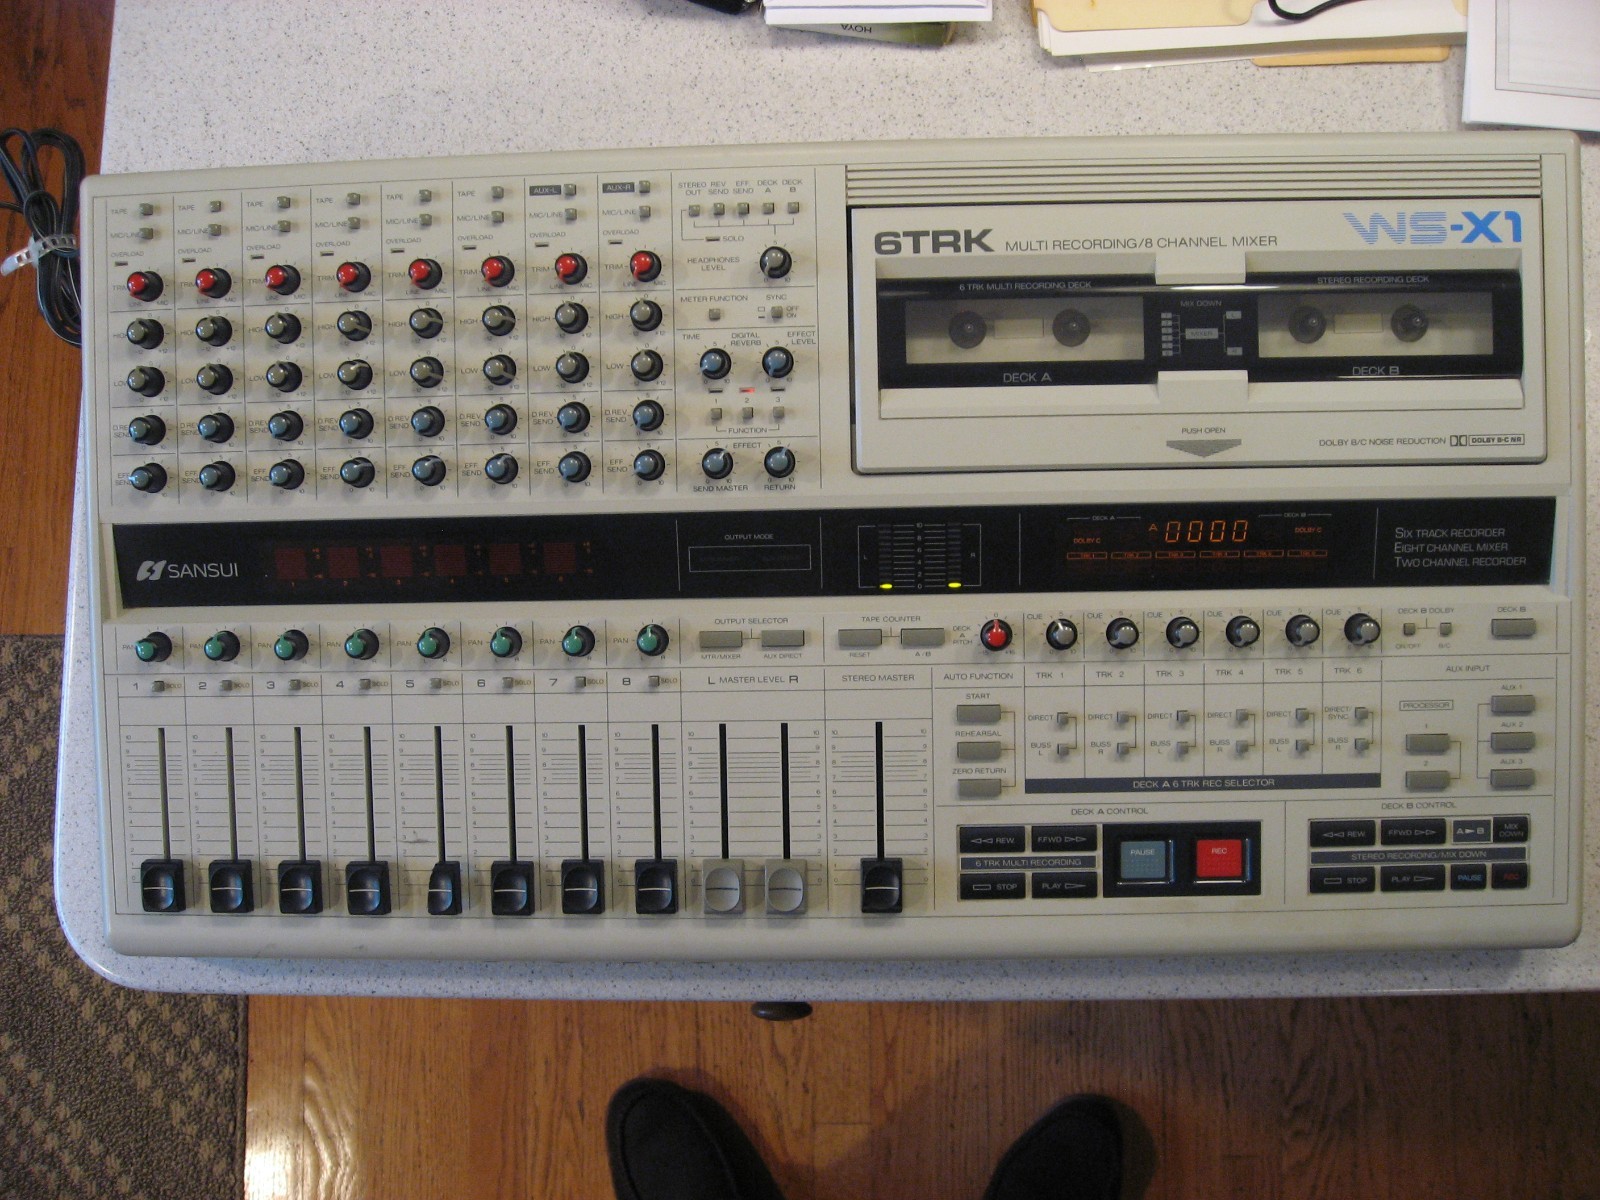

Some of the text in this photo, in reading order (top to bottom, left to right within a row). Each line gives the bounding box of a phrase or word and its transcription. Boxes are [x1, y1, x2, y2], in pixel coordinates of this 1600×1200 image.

[841, 24, 872, 33] HOYA
[1342, 210, 1522, 245] WS-X1
[874, 228, 995, 255] 6TRK
[1005, 240, 1048, 252] MULTI
[1157, 236, 1228, 248] CHANNEL
[1232, 235, 1278, 248] MIXER
[1317, 275, 1430, 284] STEREO RECORDING DECK
[959, 280, 1092, 291] 6 TRK MULTI RECORDING DECK
[1352, 366, 1400, 376] DECK B
[1003, 372, 1052, 383] DECK A
[1164, 520, 1249, 543] 0000
[1416, 528, 1449, 538] TRACK
[1451, 528, 1506, 537] RECORDER
[1426, 544, 1475, 552] CHANNEL
[1477, 543, 1509, 552] MIXER
[1422, 558, 1470, 567] CHANNEL
[1472, 557, 1527, 566] RECORDER
[167, 561, 239, 580] SANSUI
[336, 680, 344, 688] 4
[406, 680, 415, 688] 5
[477, 679, 486, 688] 6
[549, 678, 558, 686] 7
[622, 677, 632, 686] 8
[708, 676, 716, 685] L
[789, 675, 799, 684] R
[198, 682, 208, 690] 2
[266, 681, 276, 689] 3
[1352, 853, 1386, 861] STEREO
